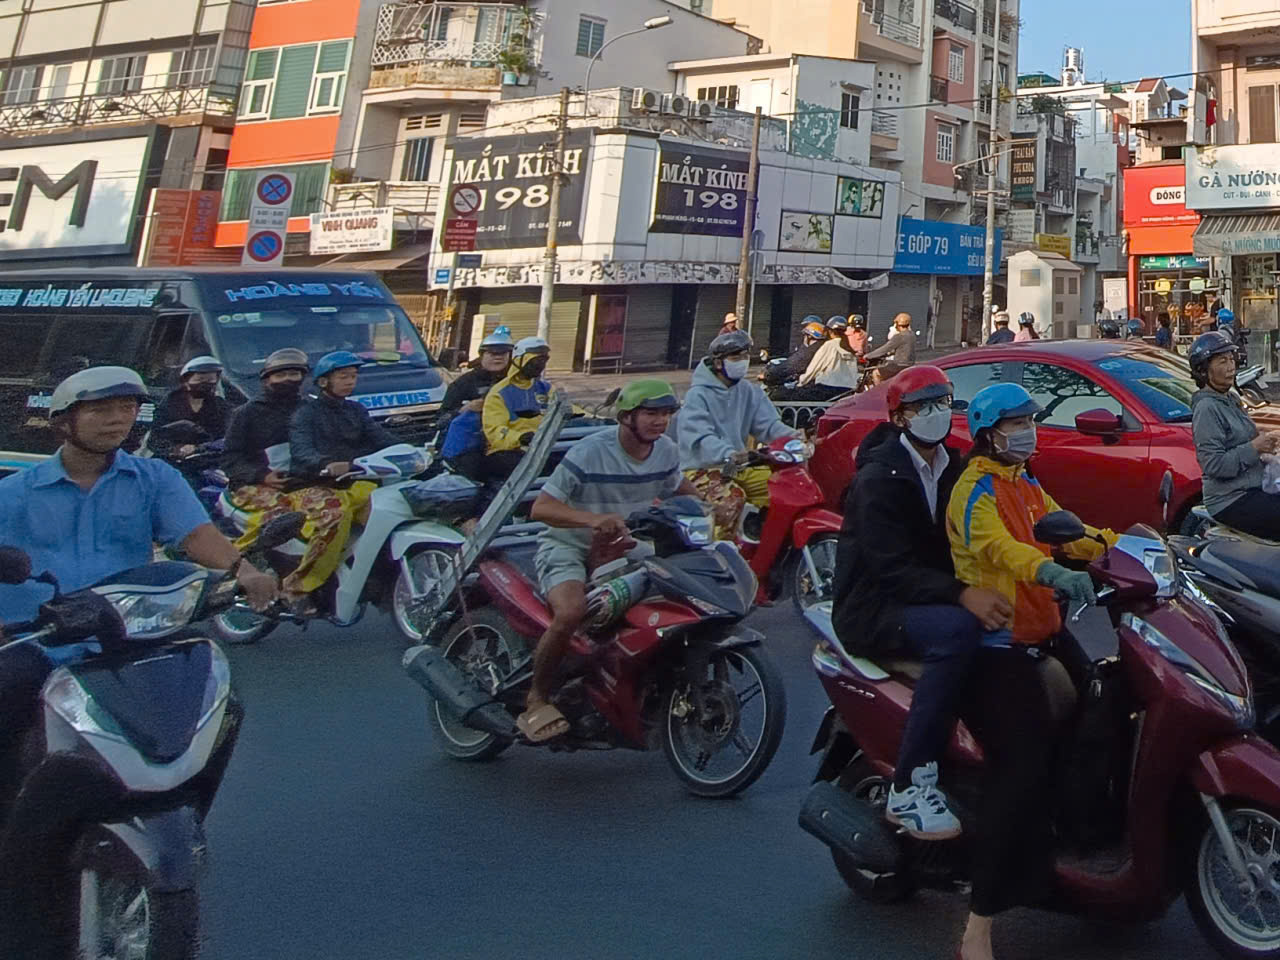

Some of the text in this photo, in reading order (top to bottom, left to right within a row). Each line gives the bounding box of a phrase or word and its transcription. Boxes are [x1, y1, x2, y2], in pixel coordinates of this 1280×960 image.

[452, 143, 583, 185] MẮT KÍNH
[660, 155, 750, 191] MẮT KÍNH
[1199, 171, 1223, 189] GÀ
[683, 188, 738, 211] 198
[896, 231, 949, 255] E GÓP 79
[960, 233, 972, 248] BÁN
[225, 280, 385, 302] HOÀNG YẾN
[357, 390, 431, 408] SKYBUS
